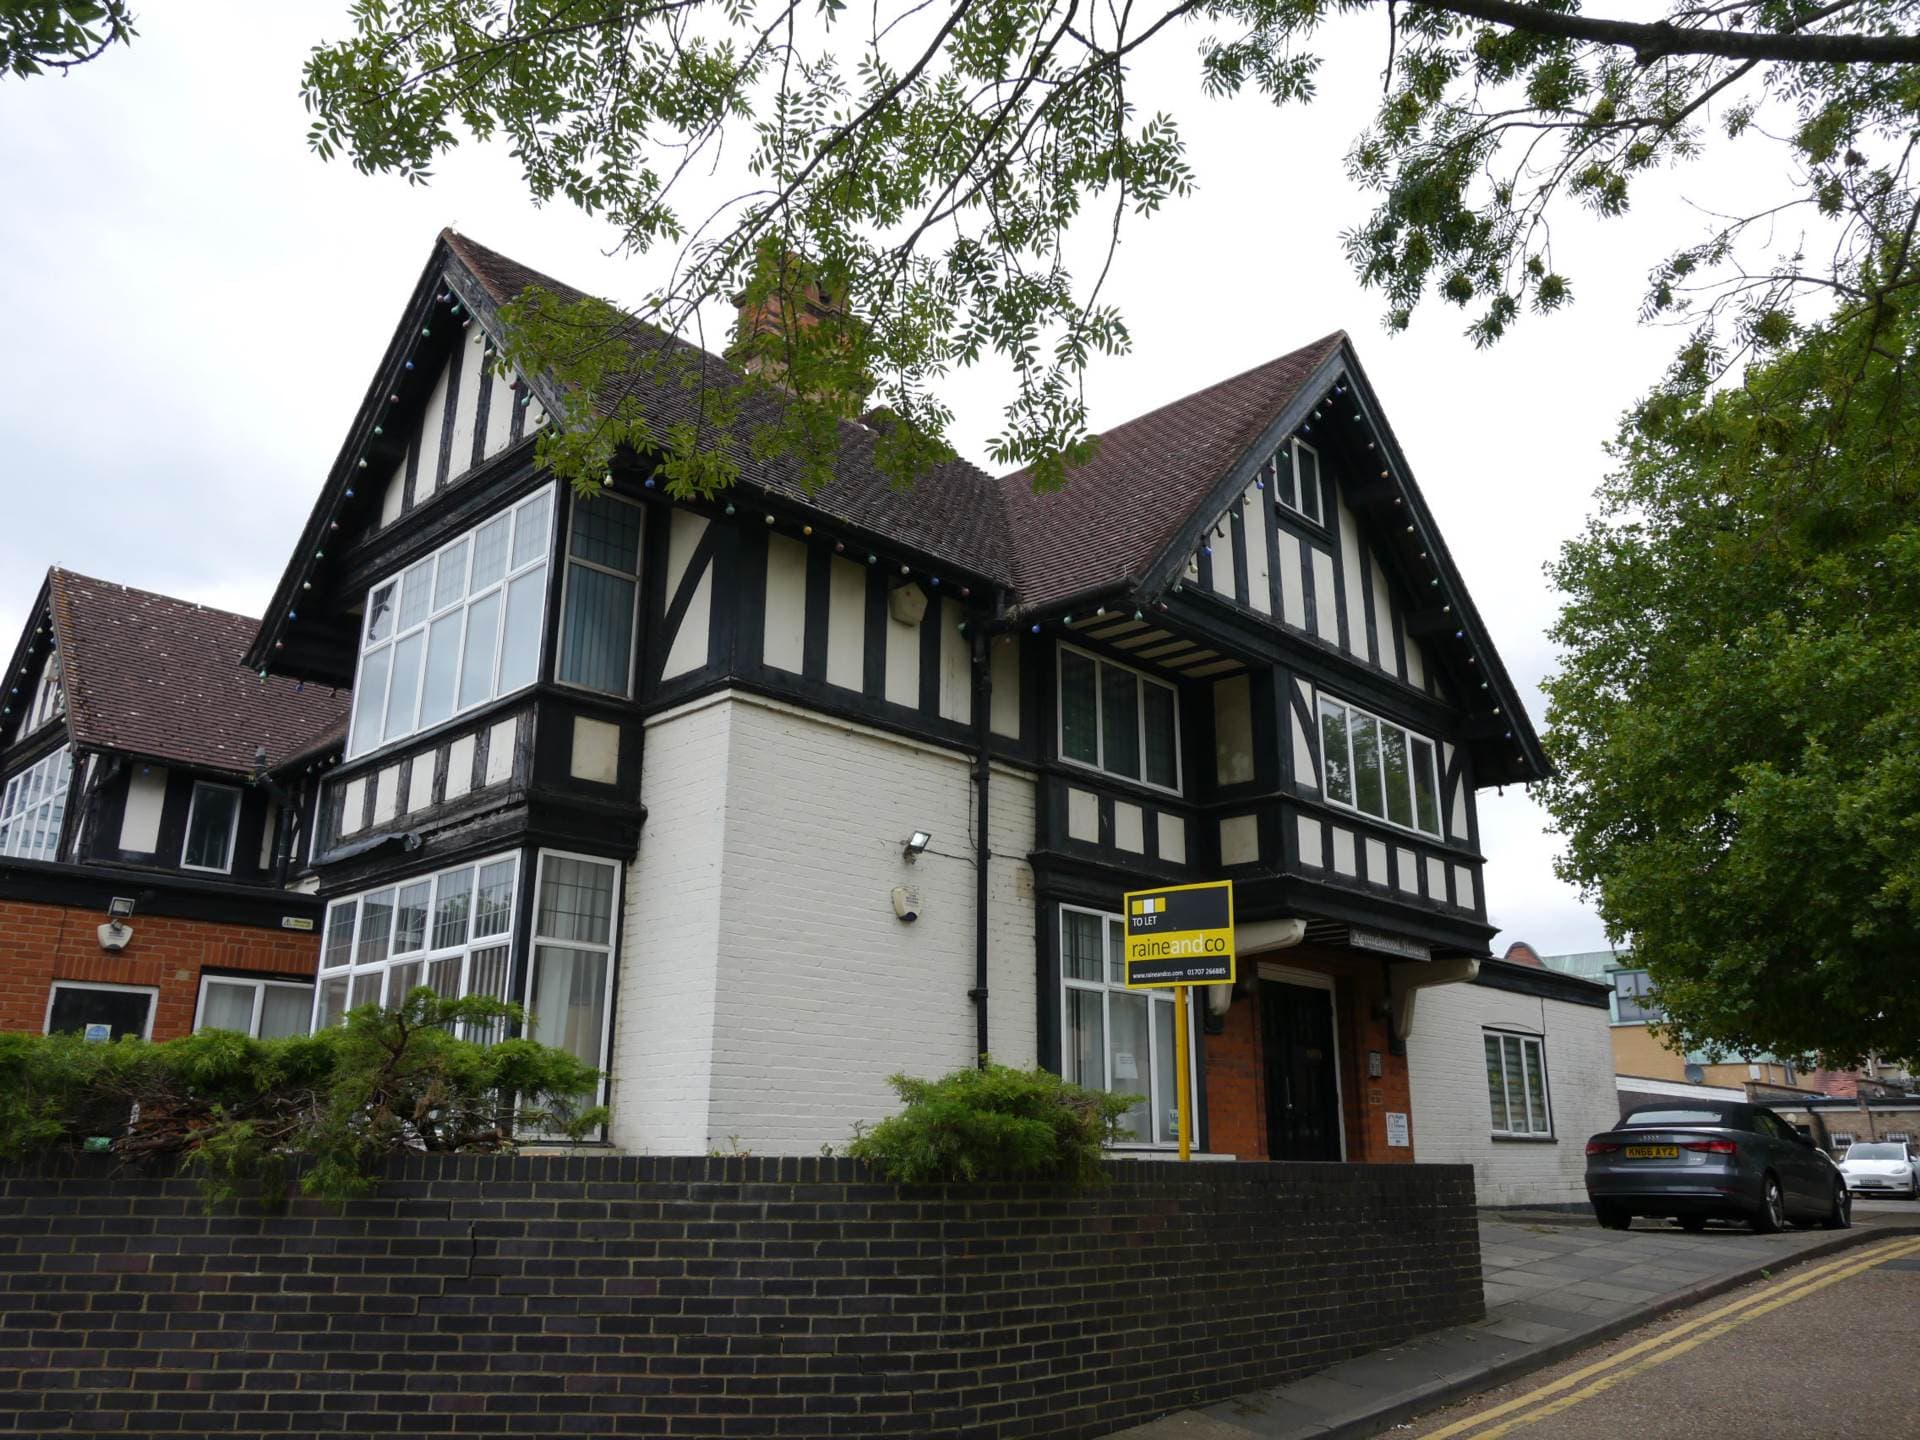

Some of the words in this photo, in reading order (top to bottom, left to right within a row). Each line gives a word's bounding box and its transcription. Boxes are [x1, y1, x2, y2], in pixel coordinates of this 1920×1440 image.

[1133, 917, 1143, 927] TO
[1144, 916, 1157, 925] LET
[1132, 934, 1225, 957] raineandco
[1187, 968, 1204, 976] 01707
